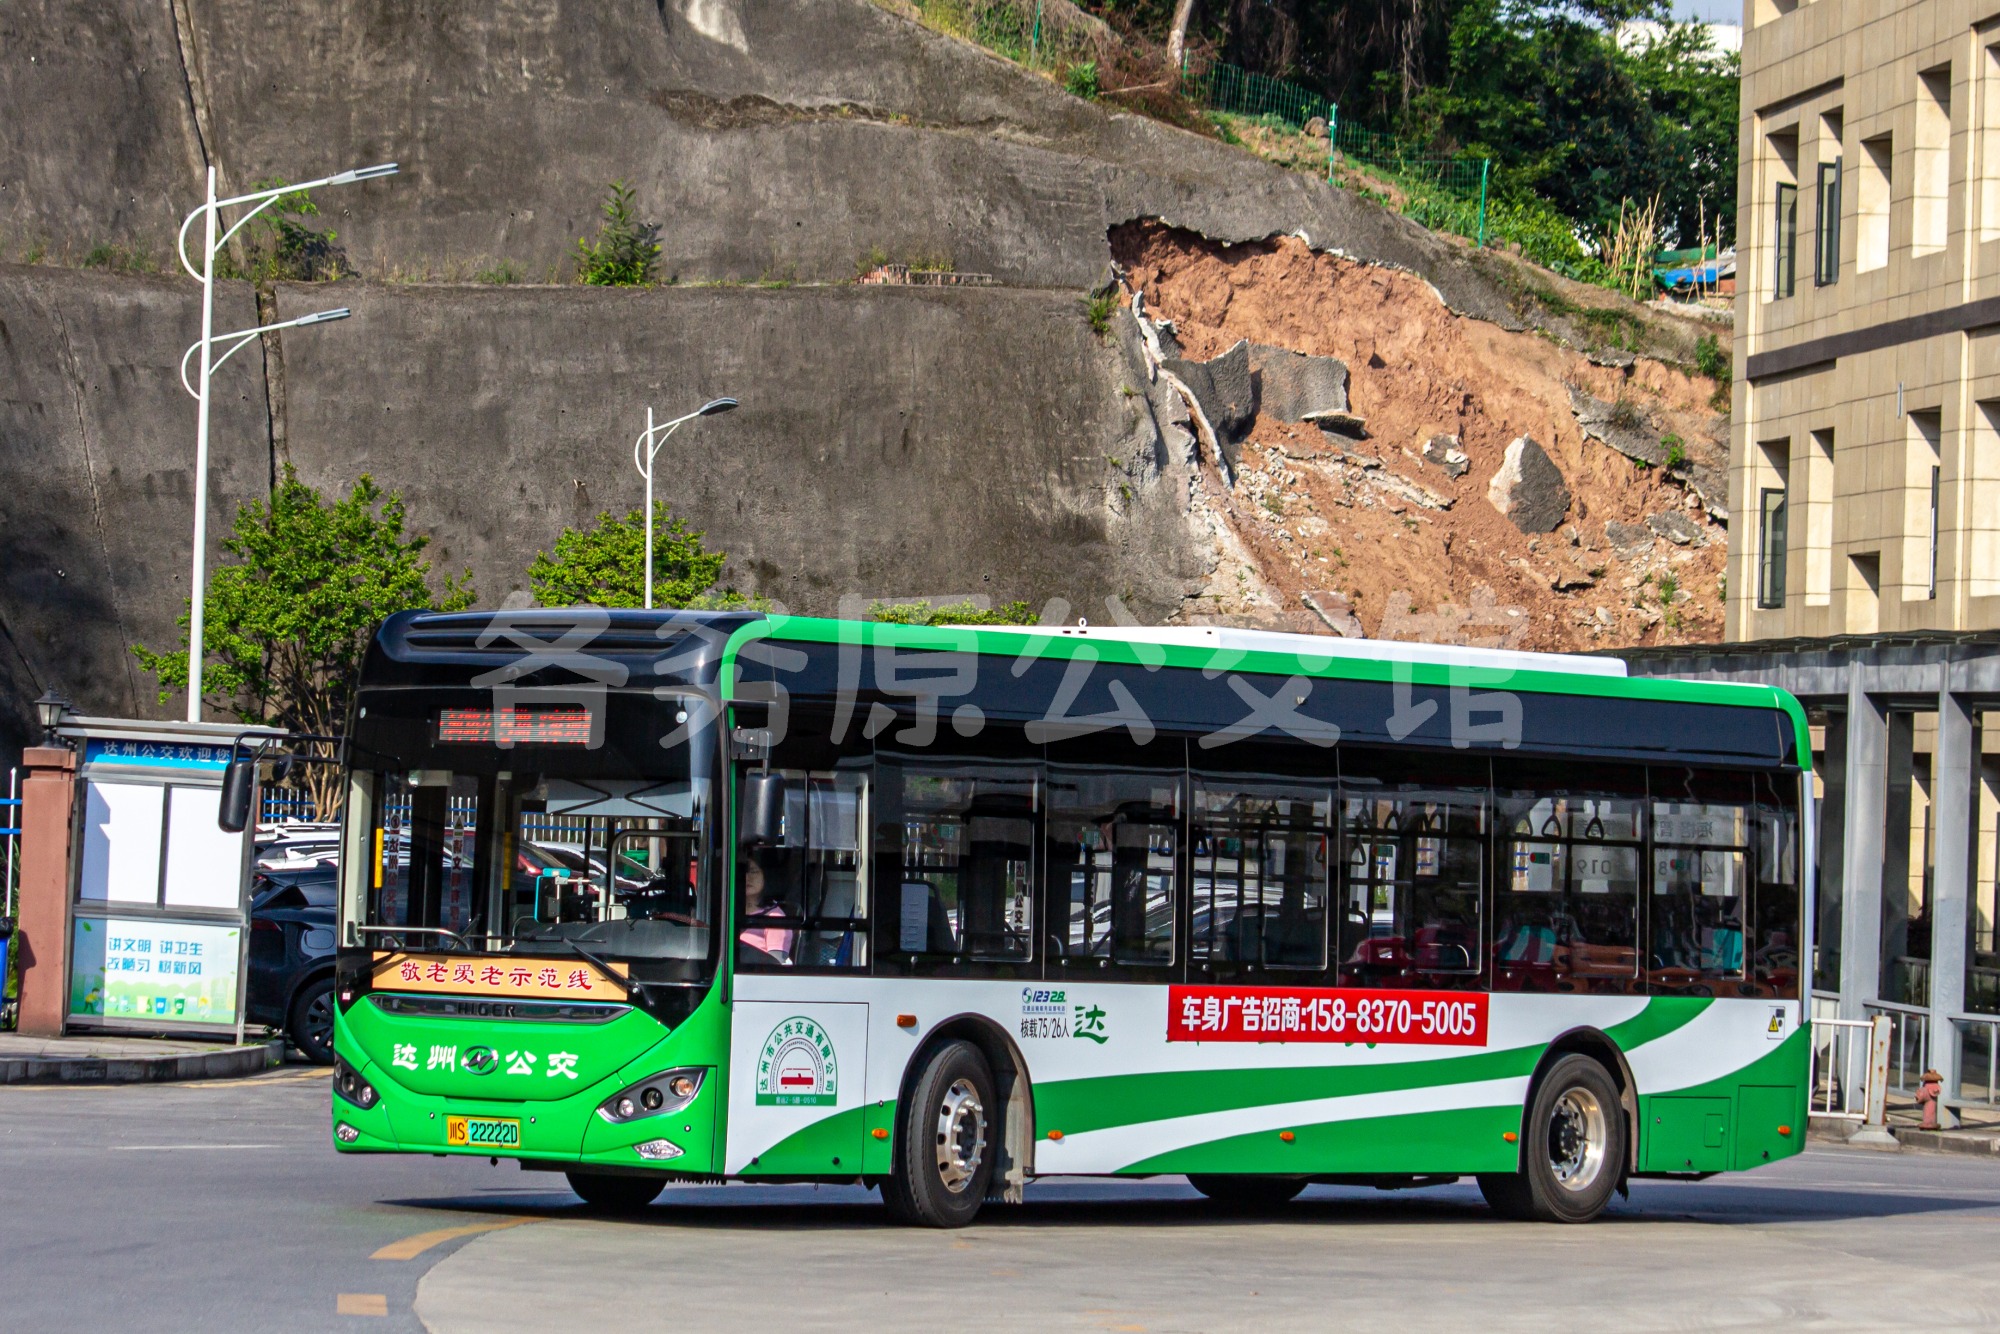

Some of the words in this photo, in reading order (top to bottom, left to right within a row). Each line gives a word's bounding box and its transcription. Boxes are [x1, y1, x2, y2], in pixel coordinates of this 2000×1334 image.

[103, 741, 231, 764] 达州公交欢迎您
[108, 937, 152, 953] 讲文明
[159, 940, 203, 956] 讲卫生
[106, 957, 151, 972] 改陋习
[158, 960, 202, 976] 树新风
[400, 962, 593, 991] 敬老爱老示范线
[1032, 990, 1066, 1003] 12328
[457, 1002, 516, 1018] HIGER
[1073, 1004, 1109, 1045] 达
[760, 1021, 835, 1092] 达州市公共交通有限公司
